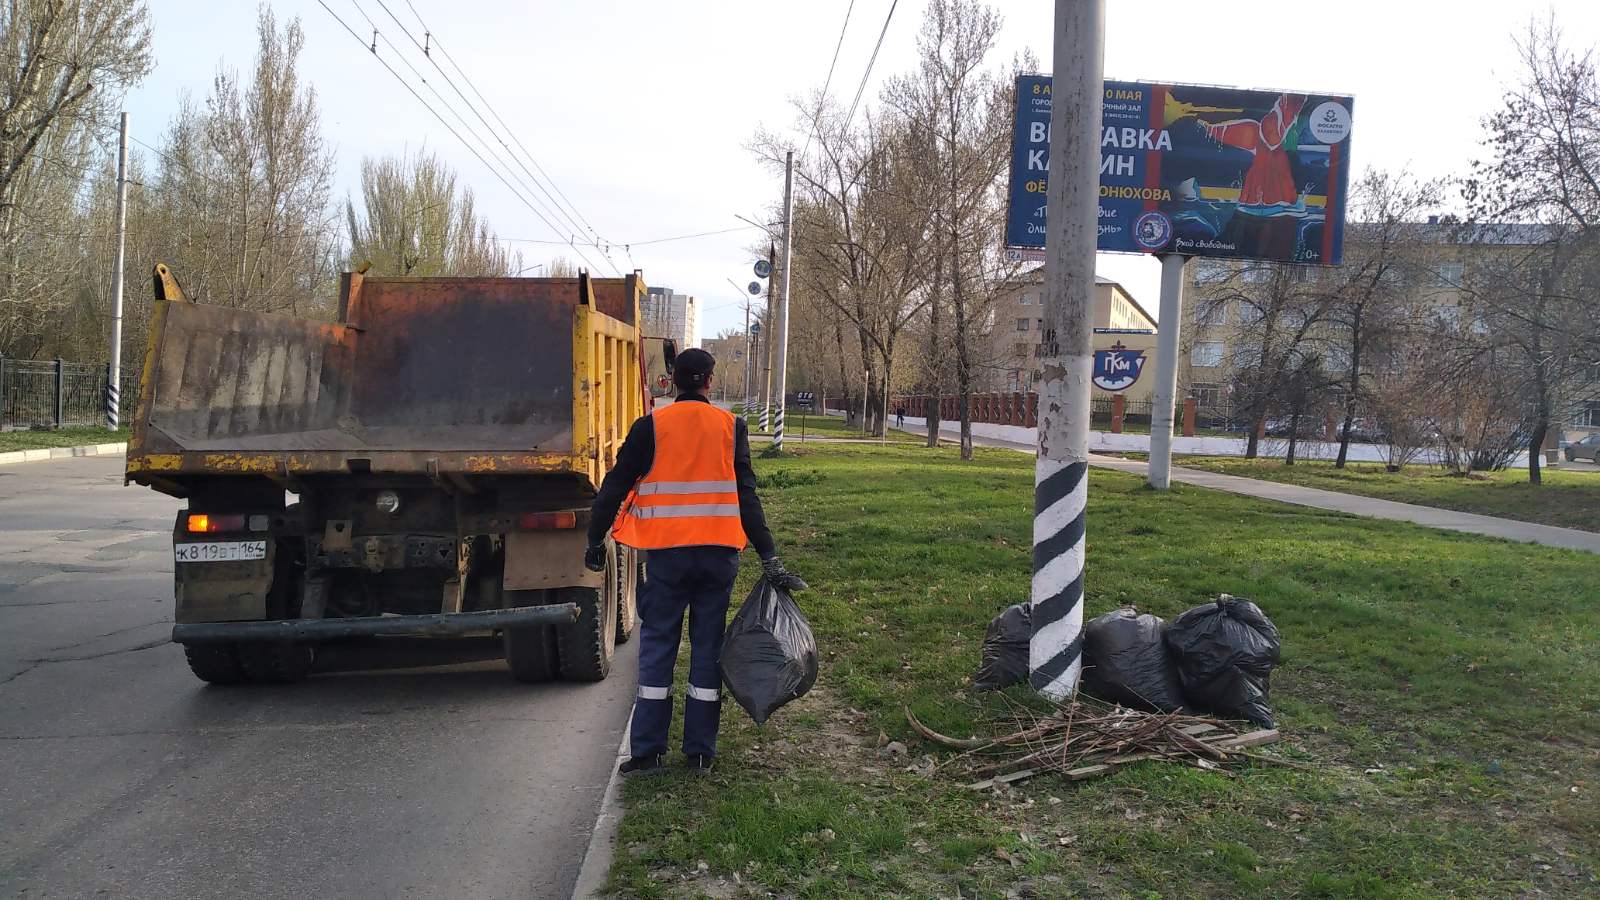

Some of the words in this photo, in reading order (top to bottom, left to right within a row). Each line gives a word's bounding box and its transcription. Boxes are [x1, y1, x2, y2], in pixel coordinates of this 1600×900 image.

[1116, 90, 1142, 101] МАЯ
[1099, 185, 1172, 201] ОНЮХОВА
[1195, 240, 1236, 250] свободный
[1306, 250, 1320, 260] 0+
[241, 543, 265, 553] 164
